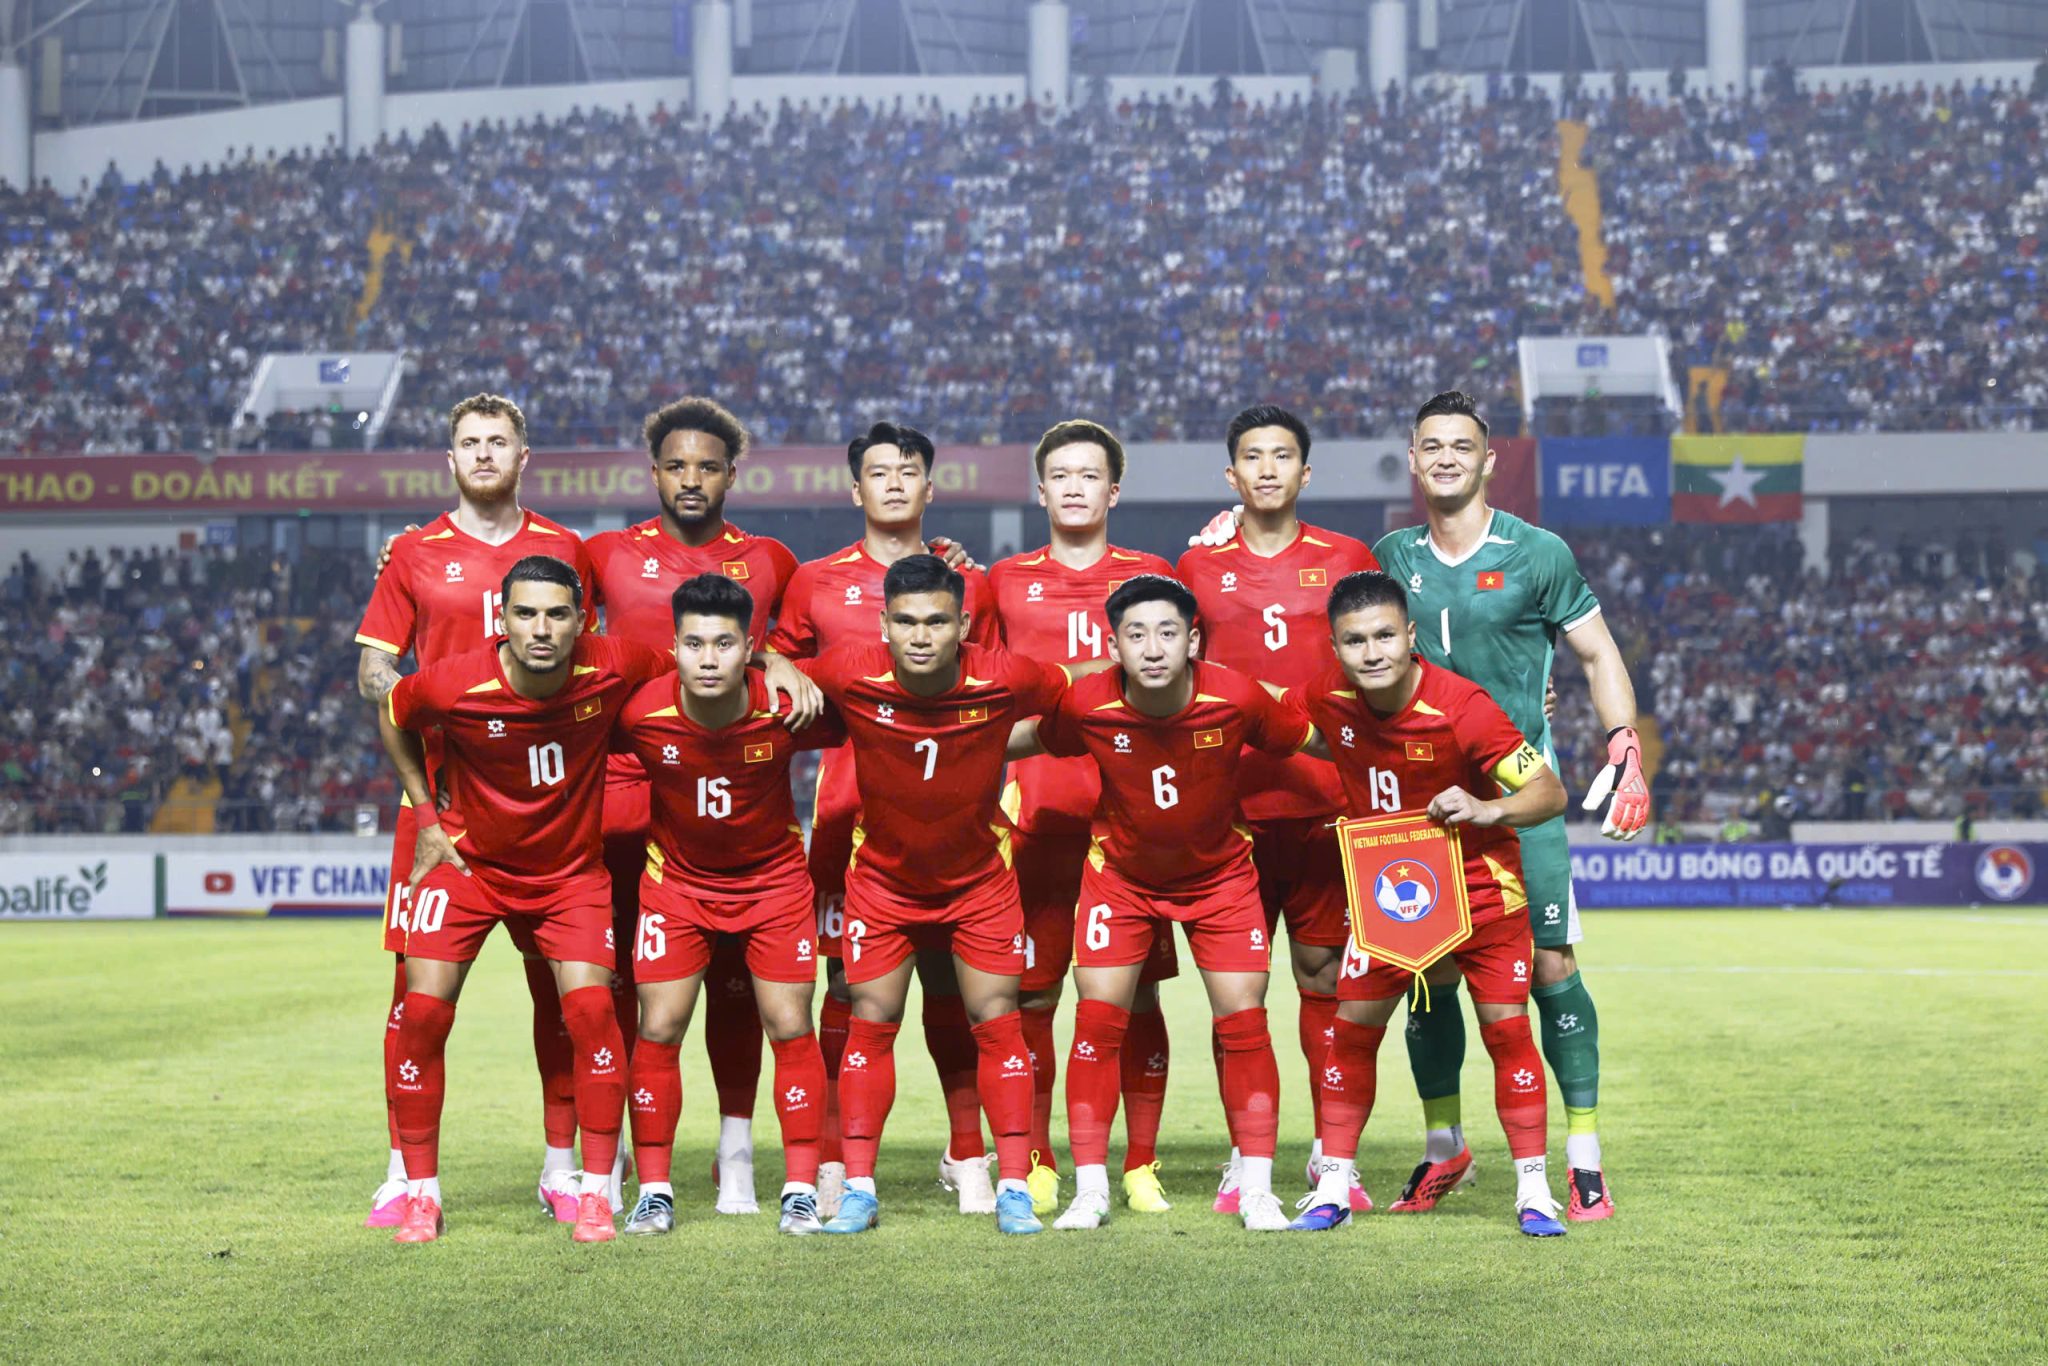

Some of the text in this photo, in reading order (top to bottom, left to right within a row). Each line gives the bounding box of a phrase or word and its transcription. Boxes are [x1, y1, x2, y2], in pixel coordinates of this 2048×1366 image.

[1558, 464, 1651, 497] FIFA
[1068, 610, 1101, 659] 14
[1263, 603, 1288, 651] 5
[1441, 607, 1451, 657] 1
[528, 741, 565, 787] 10
[914, 738, 938, 781] 7
[697, 776, 732, 820] 15
[1152, 764, 1179, 810] 6
[1369, 767, 1401, 813] 19
[1353, 827, 1446, 849] VIETNAM FOOTBALL FEDERATION
[252, 866, 303, 896] VFF
[1680, 846, 1763, 880] BÓNG
[1817, 842, 1899, 882] QUỐC
[1902, 842, 1948, 879] TẾ
[411, 887, 449, 934] 10
[817, 890, 844, 938] 16
[1086, 903, 1112, 951] 6
[1400, 904, 1419, 914] VFF
[637, 913, 667, 961] 15
